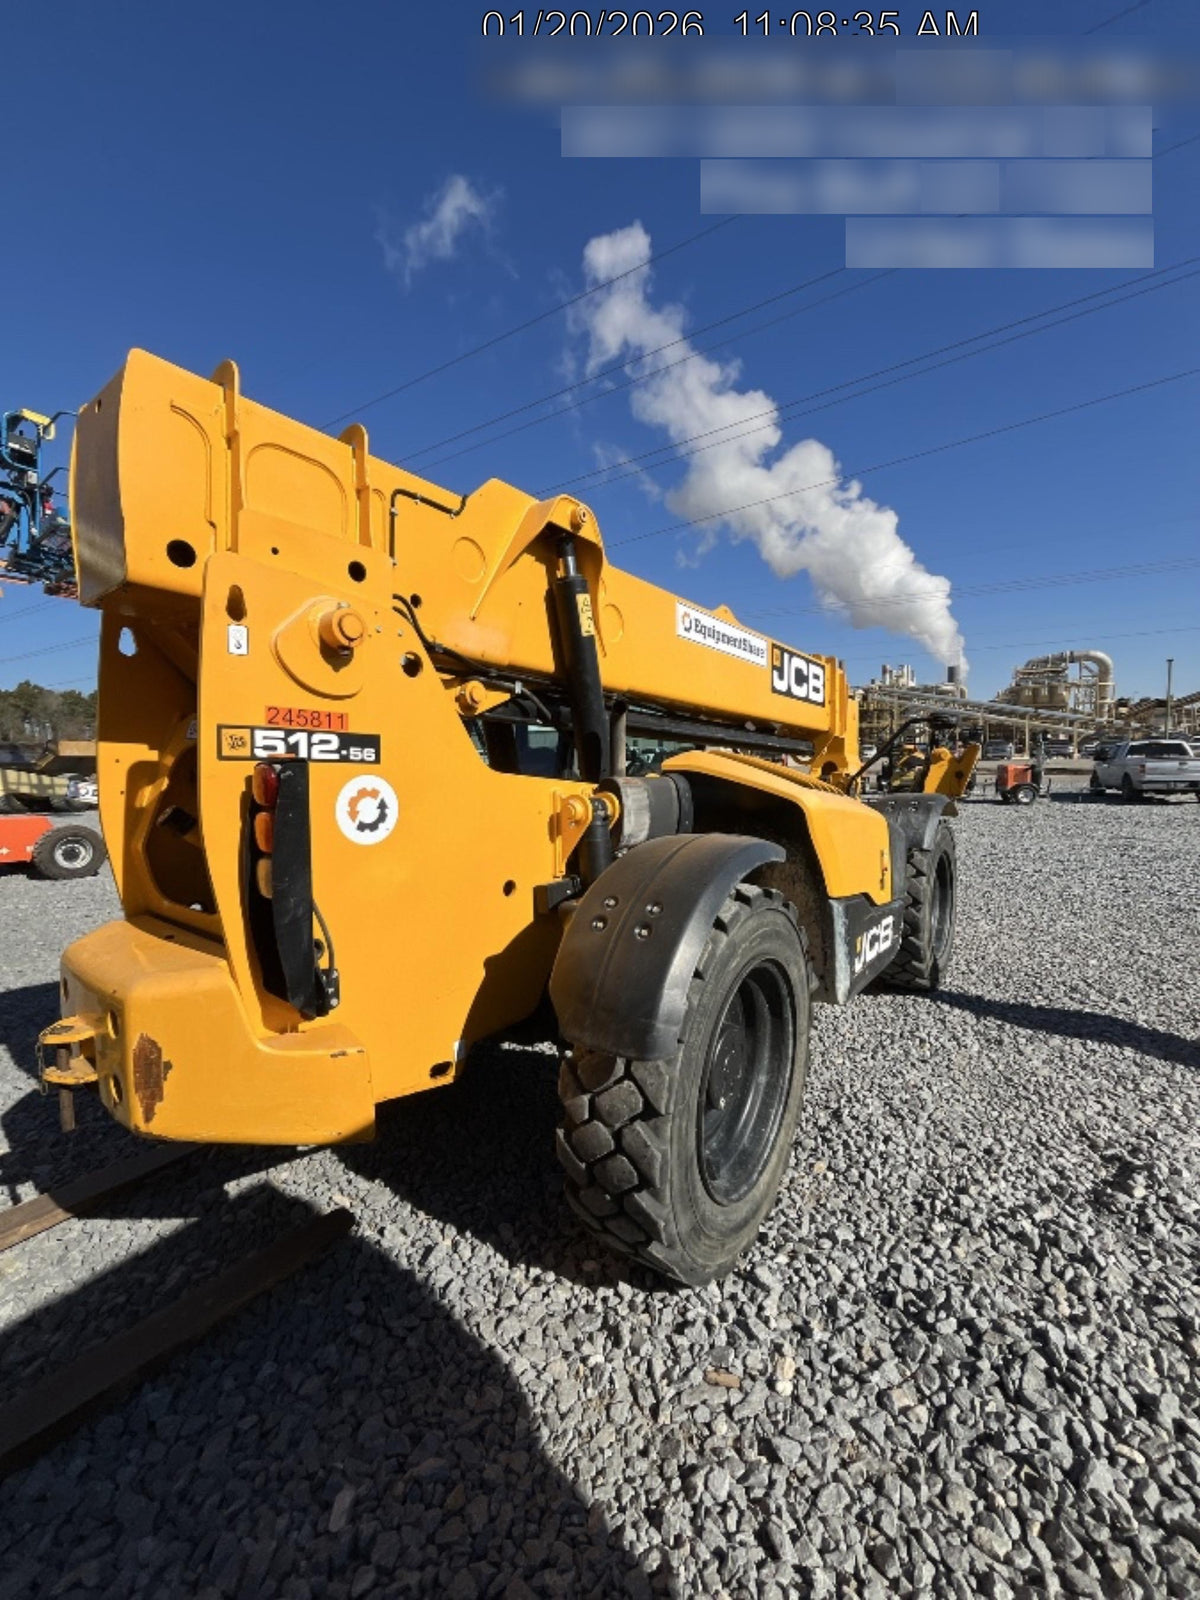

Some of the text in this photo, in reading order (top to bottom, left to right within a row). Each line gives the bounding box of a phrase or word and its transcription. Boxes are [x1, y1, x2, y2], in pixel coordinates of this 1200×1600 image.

[773, 651, 825, 704] JCB
[267, 706, 346, 729] 245811
[854, 914, 894, 974] JCB
